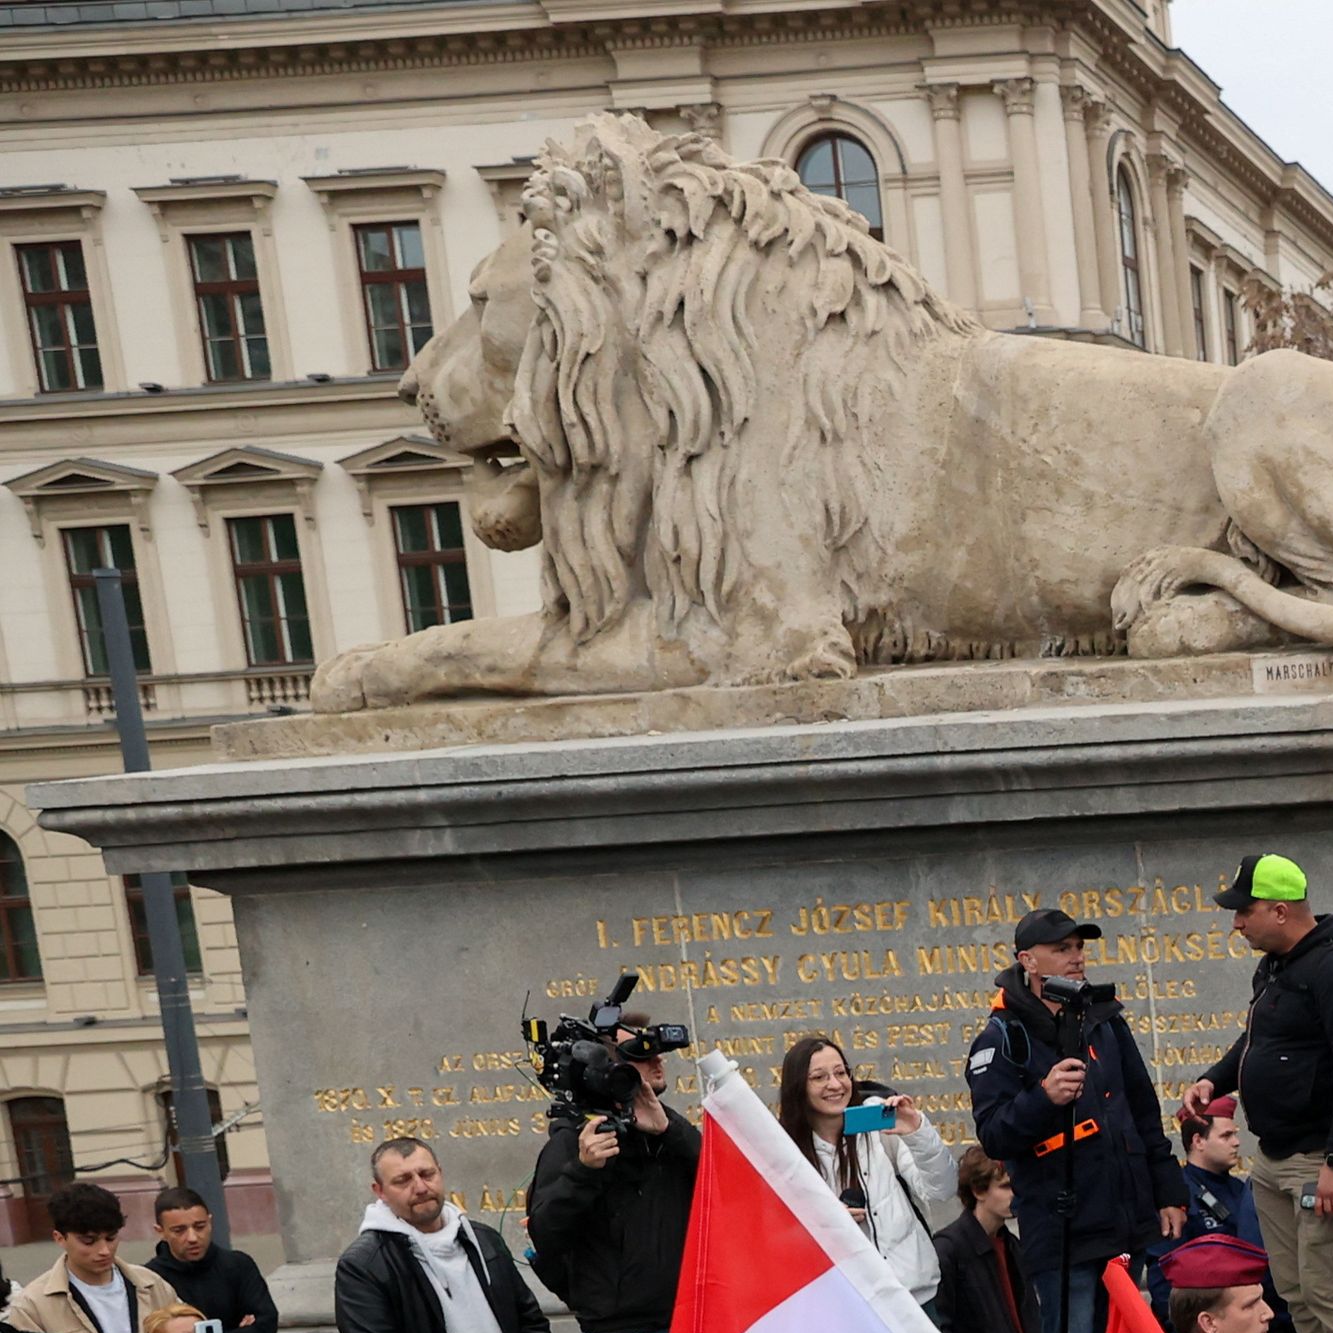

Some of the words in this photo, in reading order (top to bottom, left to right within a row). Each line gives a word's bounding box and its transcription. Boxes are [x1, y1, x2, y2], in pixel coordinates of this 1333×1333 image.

[632, 909, 775, 948] FERENCZ
[790, 897, 912, 936] JÓZSEF
[928, 885, 1041, 928] KIRÁLY
[620, 950, 781, 993] NDRÁSSY
[797, 947, 903, 984] GYULA
[706, 1004, 721, 1023] A
[731, 998, 825, 1022] NEMZET
[887, 1021, 952, 1048] PEST
[438, 1054, 464, 1075] AZ
